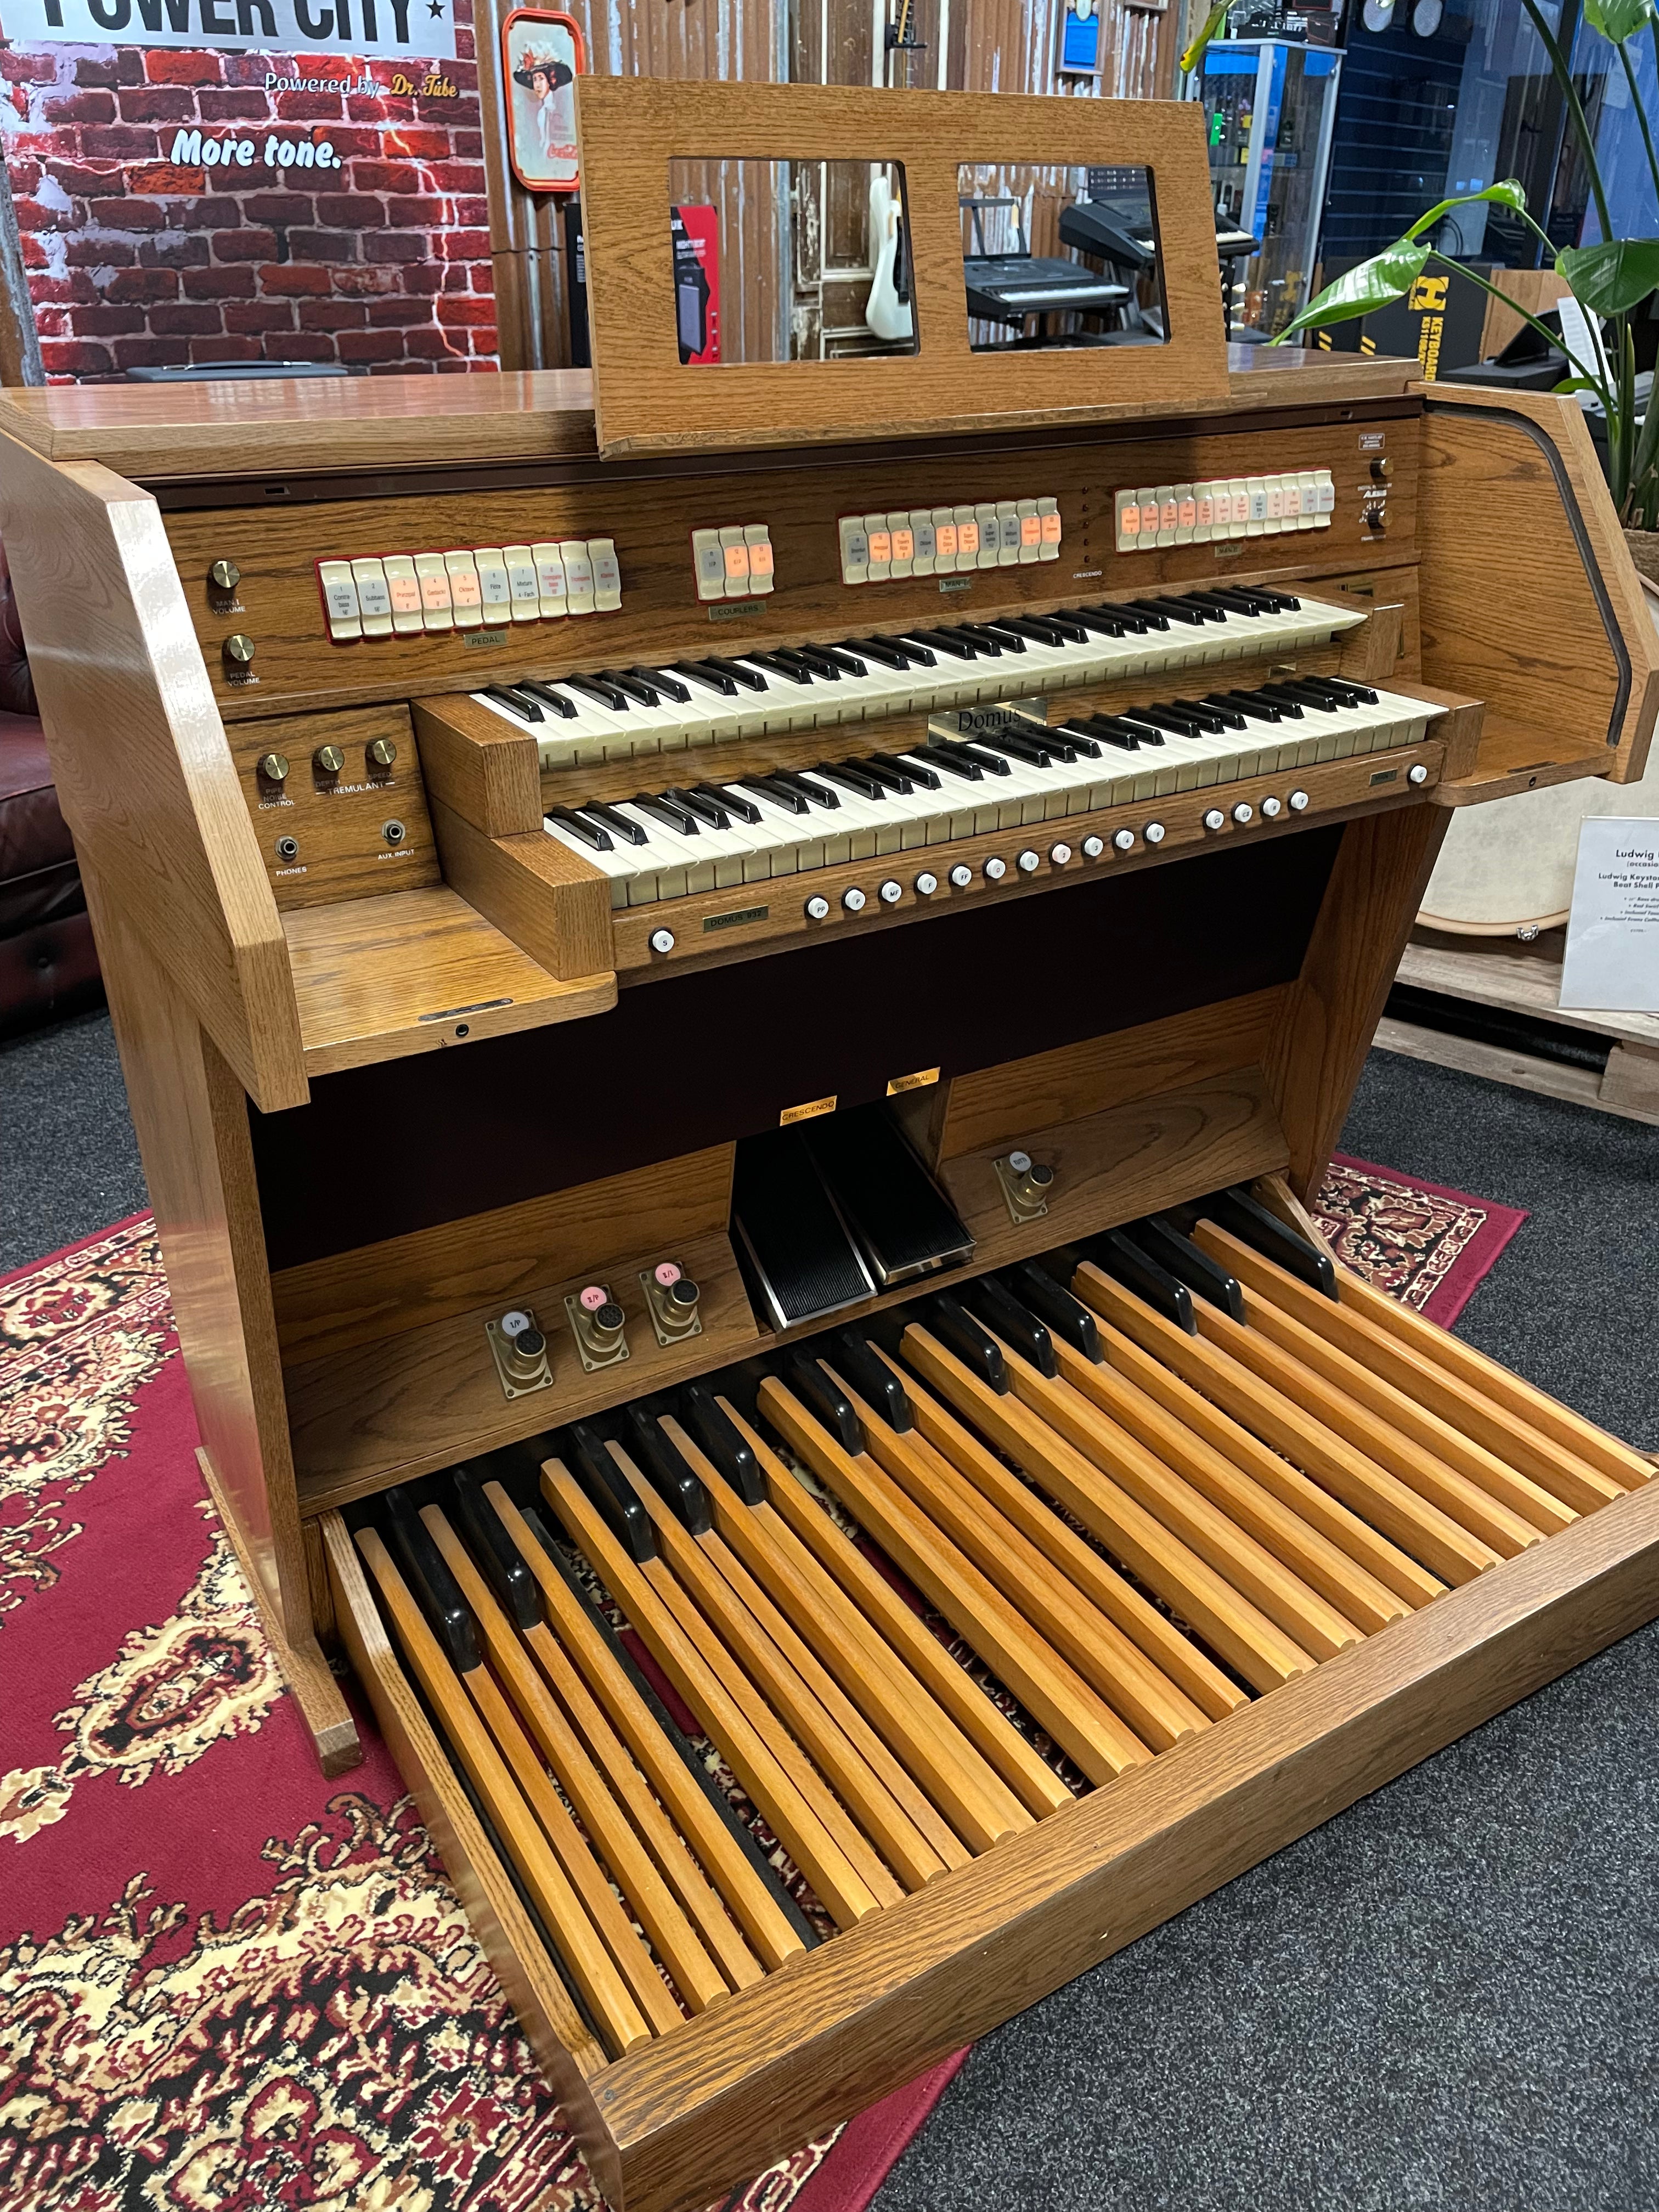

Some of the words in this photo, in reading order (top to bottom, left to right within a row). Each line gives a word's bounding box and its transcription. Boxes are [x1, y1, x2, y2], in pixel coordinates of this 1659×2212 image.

[265, 72, 351, 93] Powered
[357, 75, 379, 99] by
[391, 74, 418, 95] Dr.
[171, 129, 255, 166] More
[264, 135, 341, 168] tone.
[1425, 316, 1443, 381] KEYBOARD
[1073, 570, 1102, 579] CRESCENDO
[212, 606, 246, 615] VOLUME
[718, 605, 759, 615] COUPLERS
[471, 635, 500, 645] PEDAL
[230, 671, 256, 679] PEDAL
[228, 678, 261, 687] VOLUME
[958, 708, 1021, 732] Domus
[368, 771, 392, 780] SPEED
[315, 779, 341, 788] DEPTH
[328, 780, 383, 795] TREMULANT
[263, 793, 287, 803] NOISE
[258, 800, 296, 810] CONTROL
[395, 849, 415, 857] INPUT
[1616, 849, 1654, 861] Ludwig
[276, 866, 307, 877] PHONES
[1599, 872, 1628, 882] Ludwig
[710, 914, 743, 927] DOMUS
[895, 1074, 929, 1089] GENERAL
[782, 1101, 835, 1121] CRESCENDO
[510, 1319, 521, 1328] I/P
